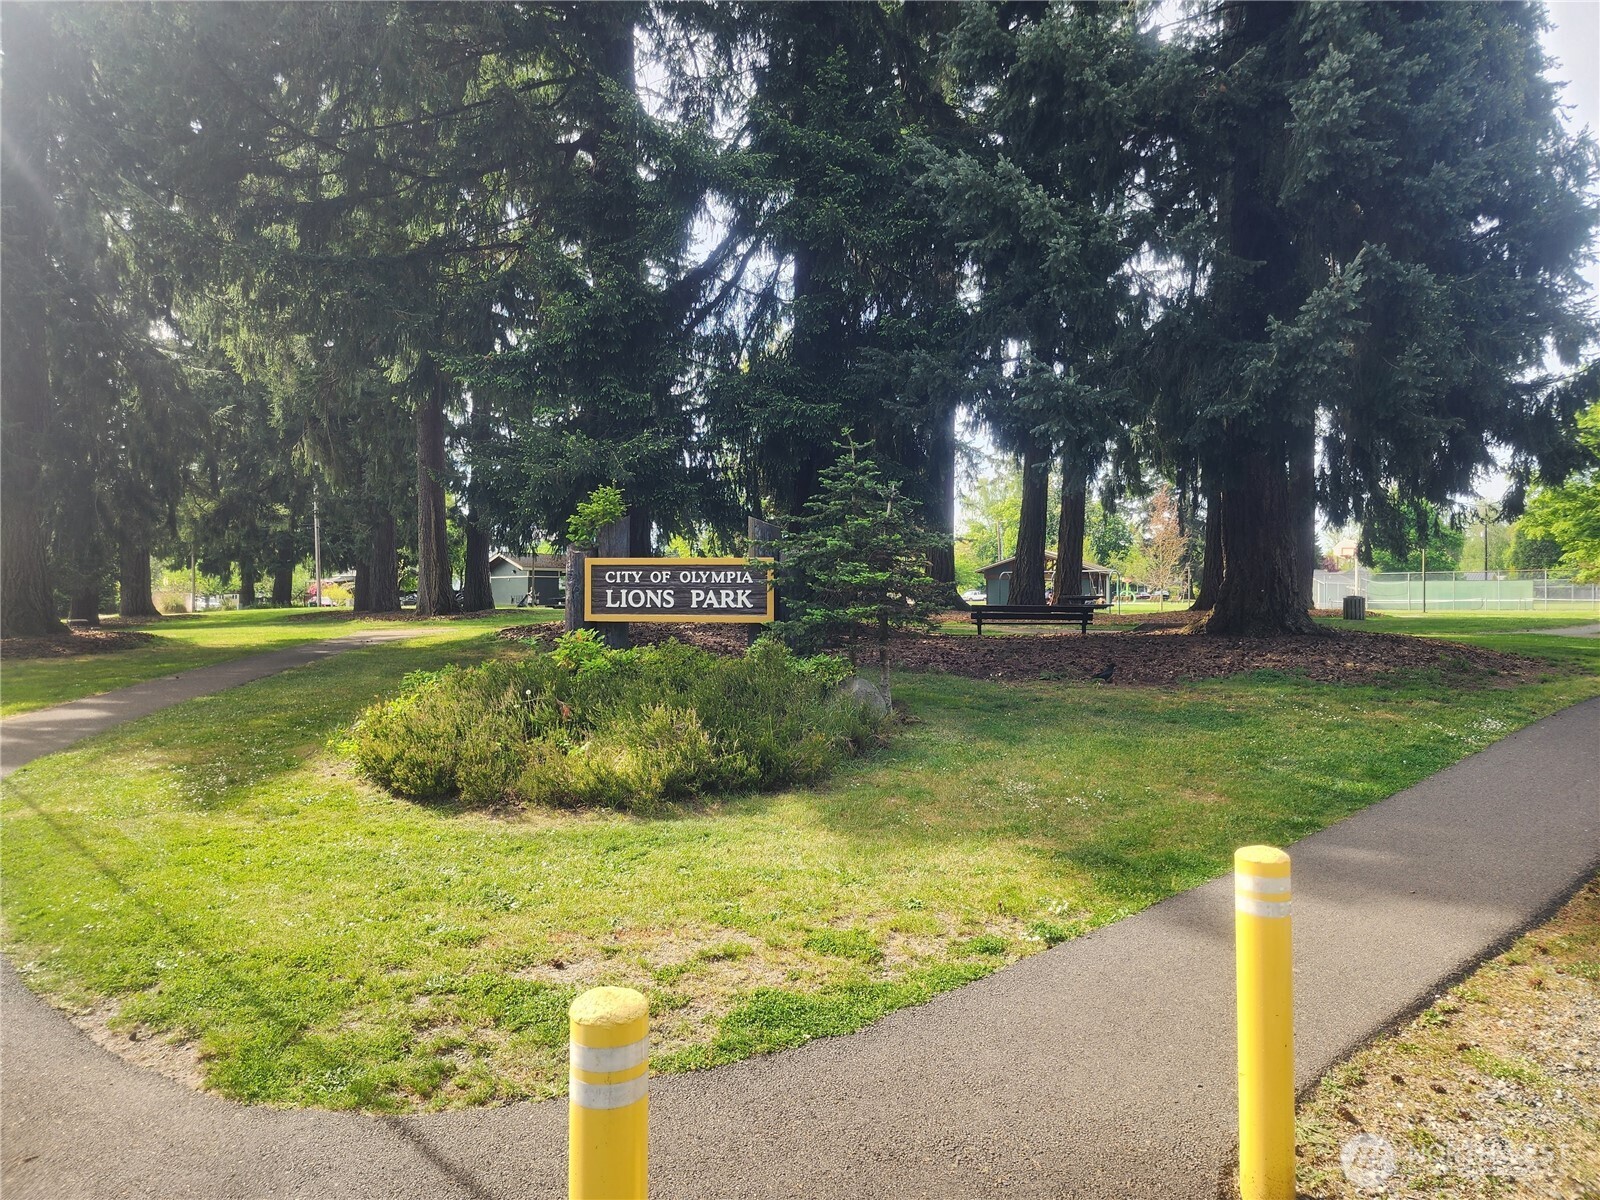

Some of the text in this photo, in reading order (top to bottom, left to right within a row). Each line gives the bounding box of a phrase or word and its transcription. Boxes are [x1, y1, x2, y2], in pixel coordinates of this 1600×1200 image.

[605, 571, 753, 583] CITY OF OLYMPIA
[605, 589, 753, 608] LIONS PARK
